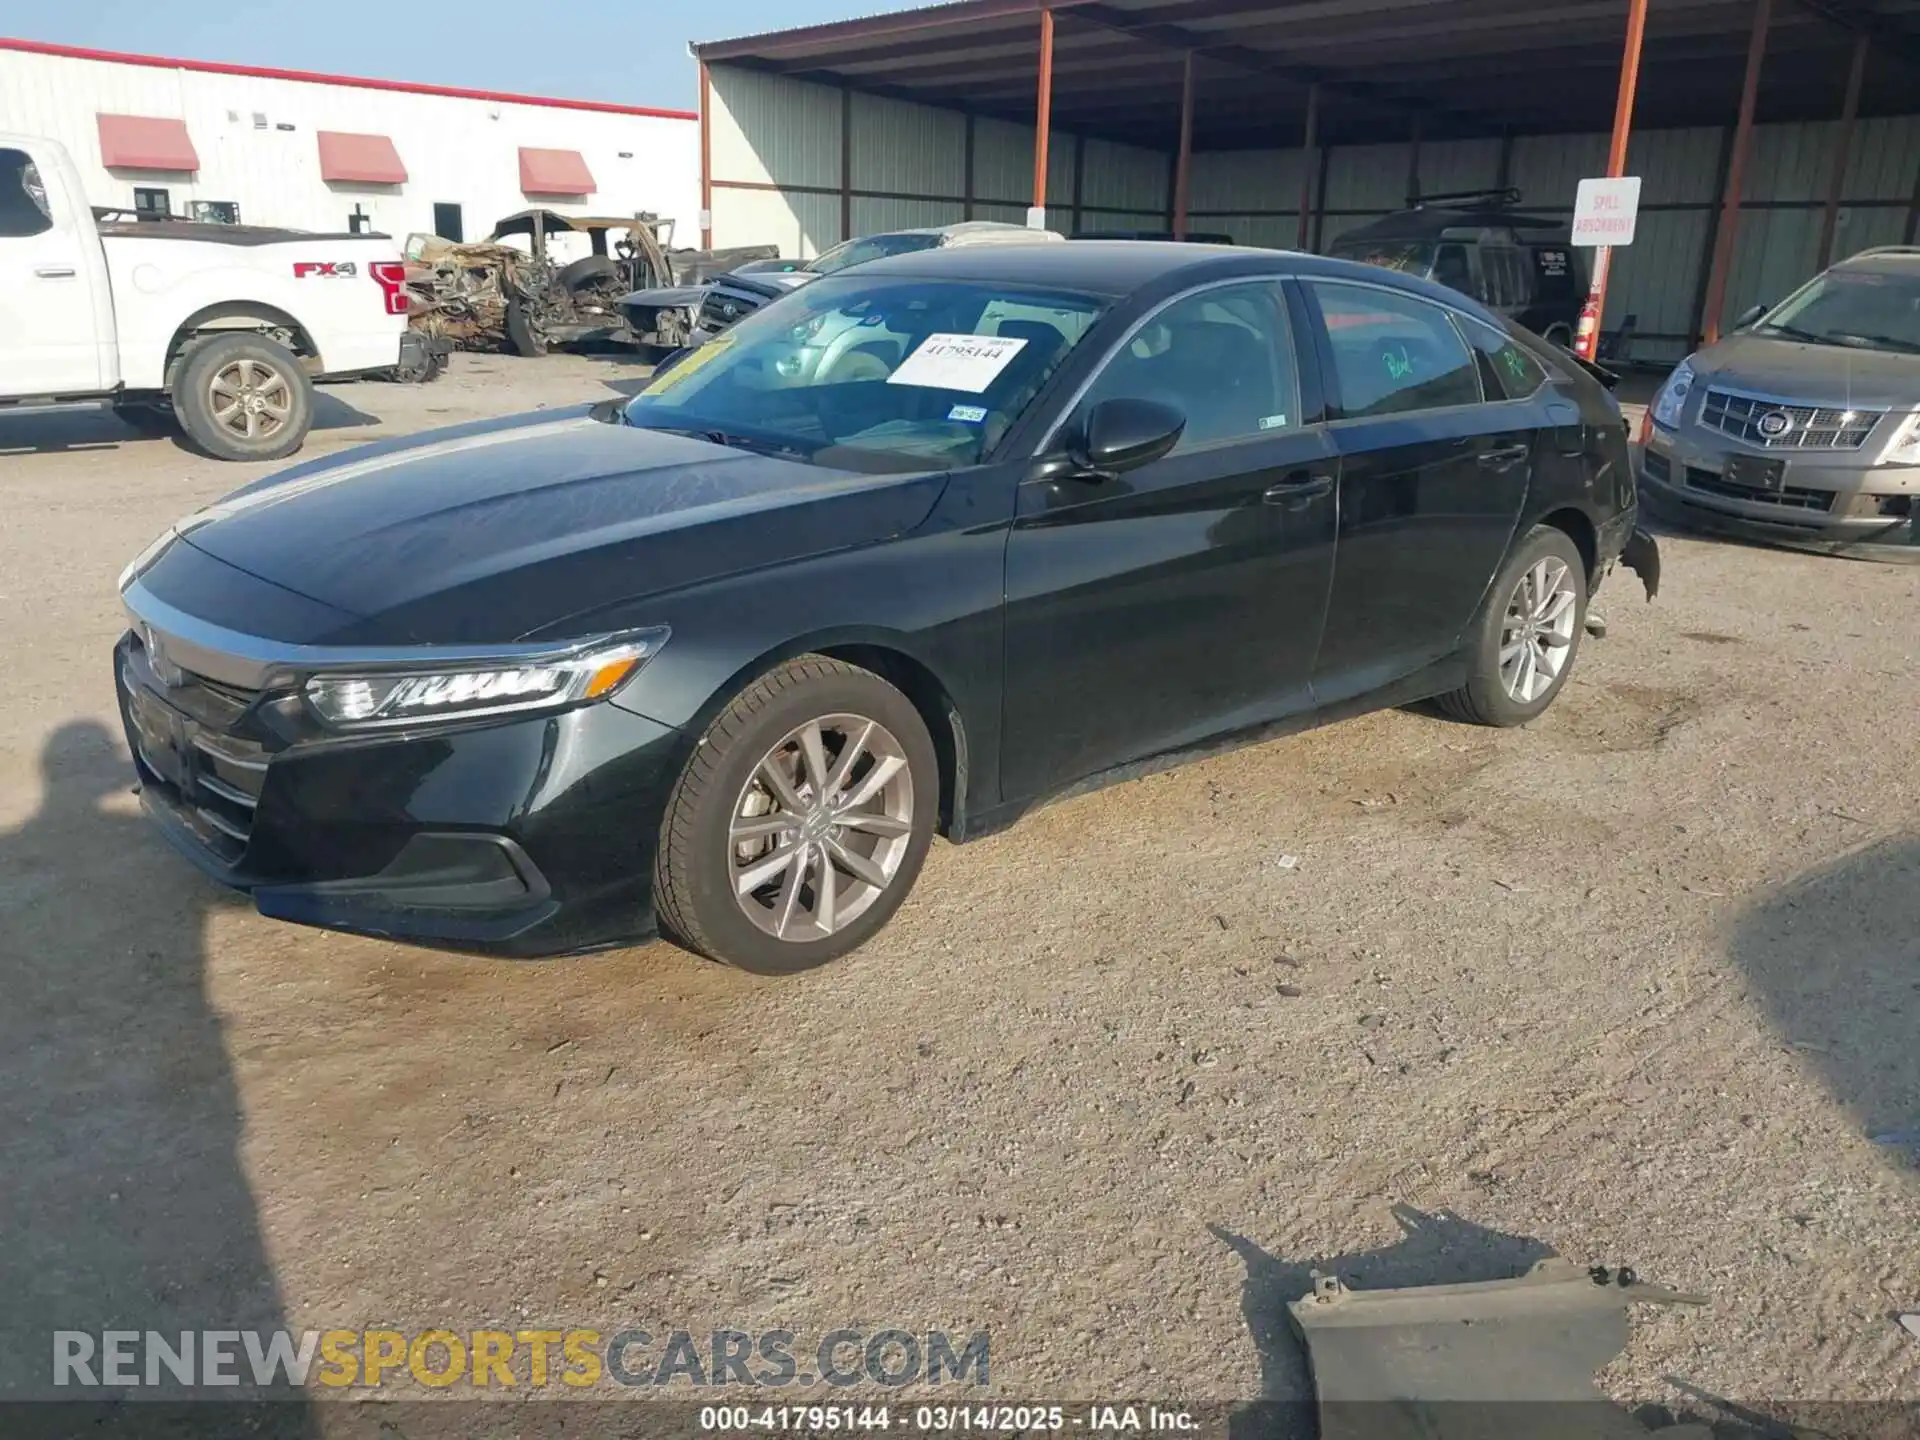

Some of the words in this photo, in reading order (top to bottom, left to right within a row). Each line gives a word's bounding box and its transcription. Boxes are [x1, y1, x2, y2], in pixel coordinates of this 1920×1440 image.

[1593, 194, 1619, 210] SPILL
[293, 262, 357, 278] FX4
[925, 343, 1004, 359] 41795144
